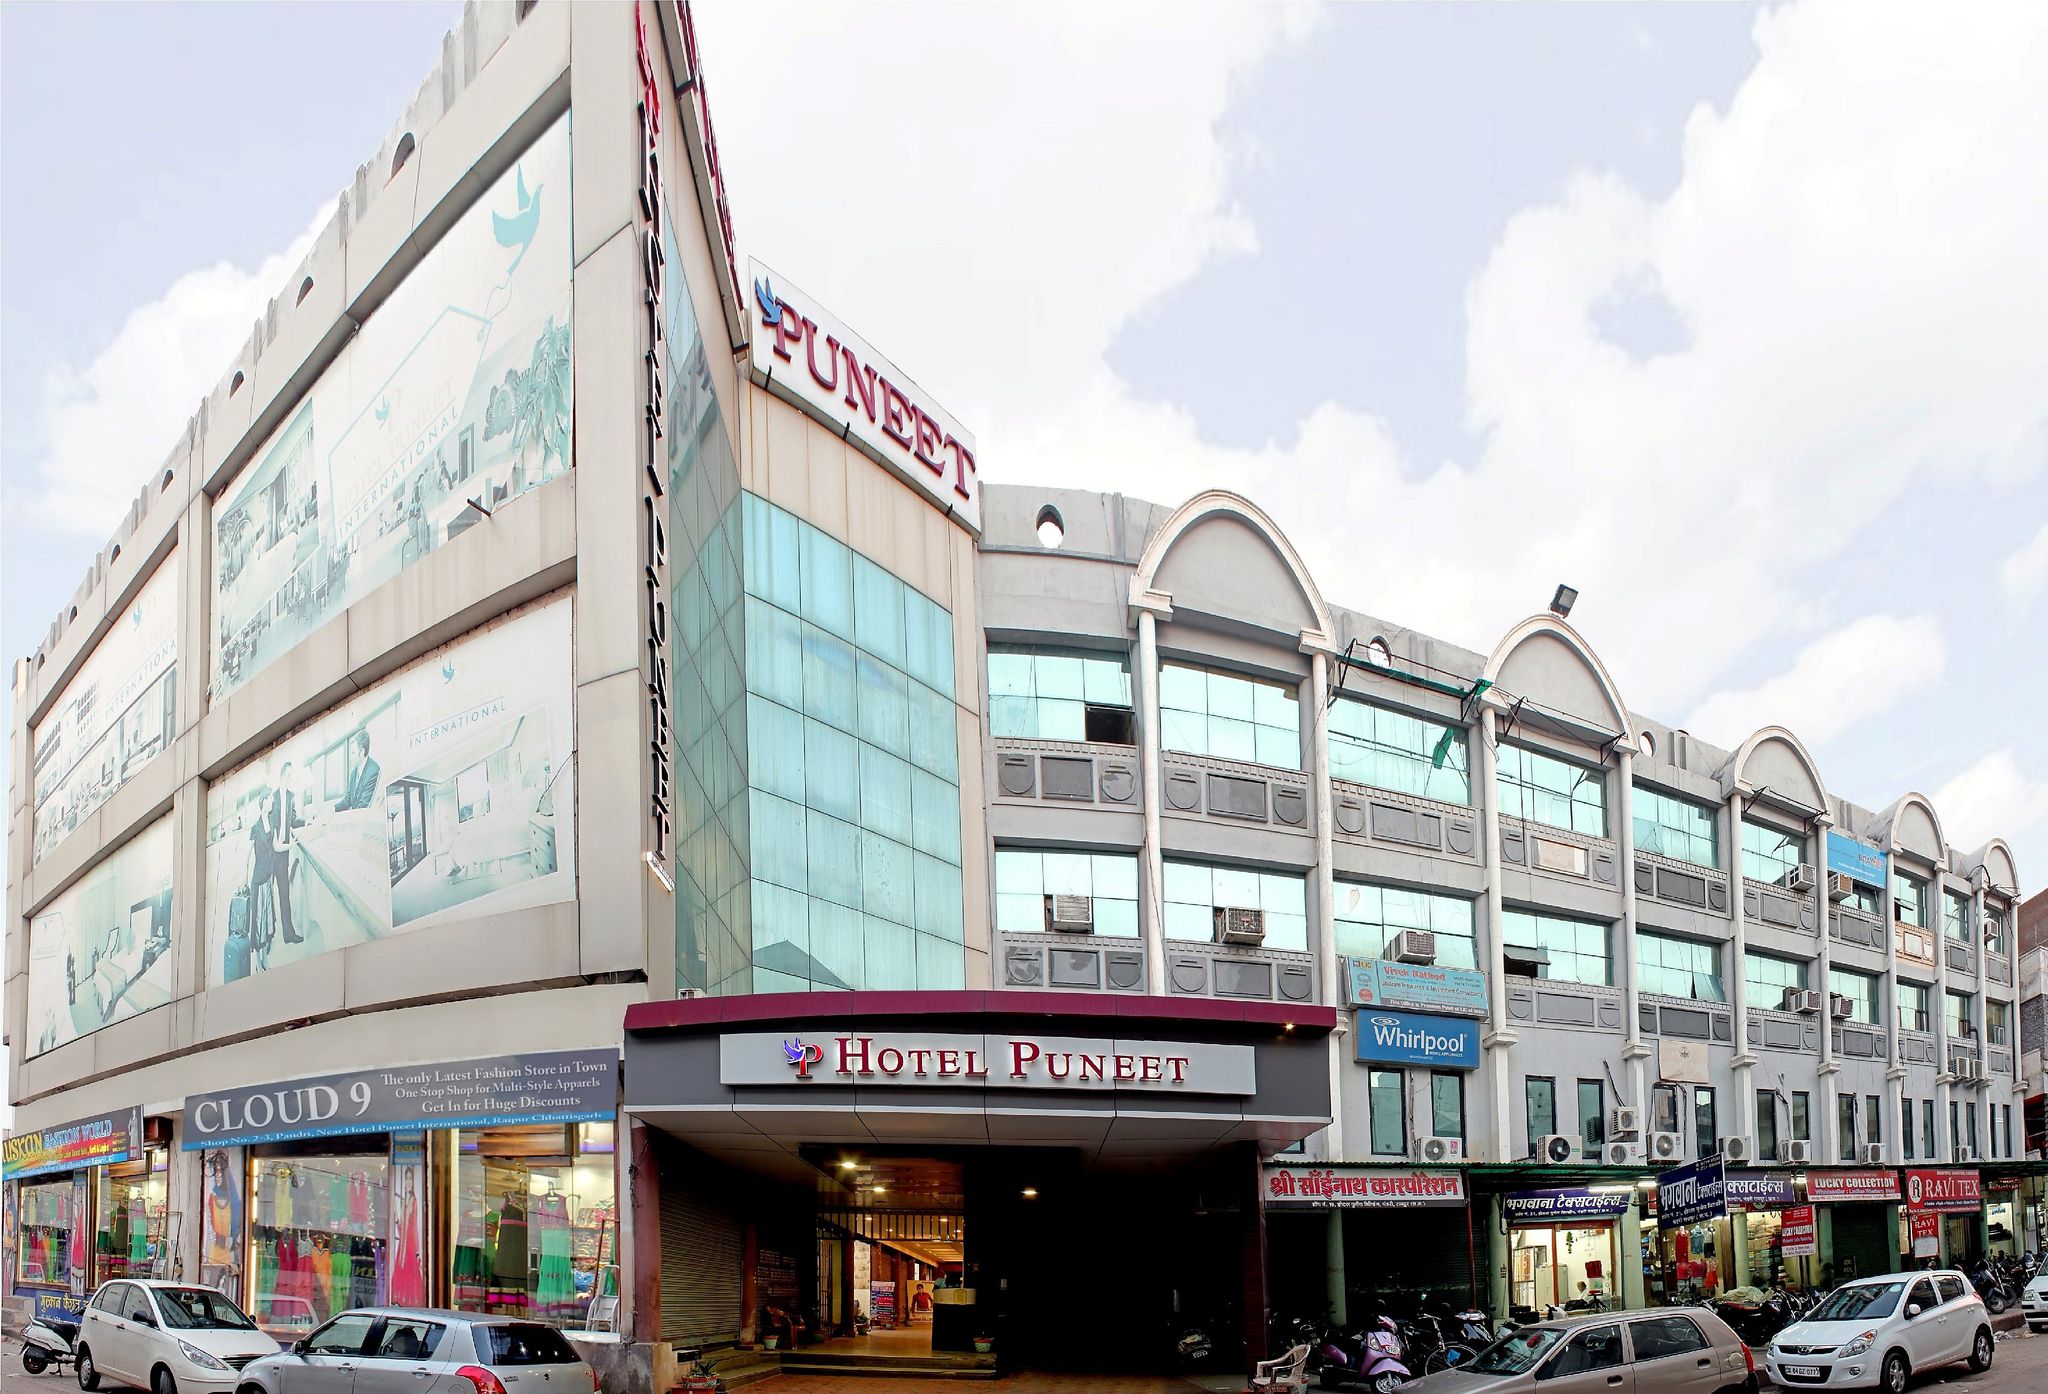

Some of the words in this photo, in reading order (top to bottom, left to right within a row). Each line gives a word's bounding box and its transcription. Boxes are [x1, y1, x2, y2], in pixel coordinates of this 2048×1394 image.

[773, 300, 977, 501] PUNEET
[338, 406, 458, 538] INTERNATIONAL
[106, 640, 177, 719] INTERNATIONA
[410, 701, 506, 749] INTERNATIONAL
[1374, 1025, 1464, 1055] Whirlpool
[380, 1073, 403, 1086] The
[406, 1072, 432, 1087] only
[435, 1069, 472, 1083] Latest
[475, 1066, 522, 1080] Fashion
[524, 1063, 556, 1076] Store
[559, 1062, 571, 1073] in
[572, 1060, 608, 1073] Town
[835, 1037, 989, 1077] HOTEL
[1009, 1040, 1190, 1083] PUNEET
[395, 1088, 418, 1099] One
[420, 1086, 445, 1100] Stop
[446, 1084, 473, 1099] Shop
[475, 1083, 491, 1095] for
[493, 1080, 553, 1094] Multi-Style
[554, 1077, 601, 1091] Apparels
[194, 1086, 340, 1133] CLOUD
[350, 1081, 372, 1117] 9
[422, 1101, 445, 1113] Get
[447, 1100, 461, 1112] In
[464, 1099, 482, 1112] for
[484, 1097, 518, 1112] Huge
[520, 1094, 581, 1108] Discounts
[2, 1132, 43, 1163] USKAN
[44, 1127, 80, 1149] FASHION
[81, 1119, 113, 1142] WORLD
[200, 1139, 228, 1147] Shop
[252, 1134, 274, 1143] 2-3,
[276, 1131, 314, 1141] Pandri,
[316, 1129, 344, 1138] Near
[345, 1124, 376, 1134] Hotel
[377, 1123, 415, 1132] Puneet
[418, 1118, 490, 1129] International,
[492, 1115, 529, 1125] Raipur
[532, 1112, 602, 1122] Chhattisgarh
[1269, 1169, 1296, 1197] श्री
[1660, 1176, 1697, 1211] भगवाना
[1726, 1174, 1785, 1195] क्सटाईल्स
[1814, 1178, 1844, 1188] LUCKY
[1846, 1177, 1895, 1188] COLLECTION
[1925, 1177, 1956, 1198] RAVI
[1957, 1179, 1979, 1197] TEX
[1506, 1197, 1555, 1210] भगवाना
[1914, 1218, 1935, 1228] RAVI
[1917, 1229, 1933, 1237] TEX
